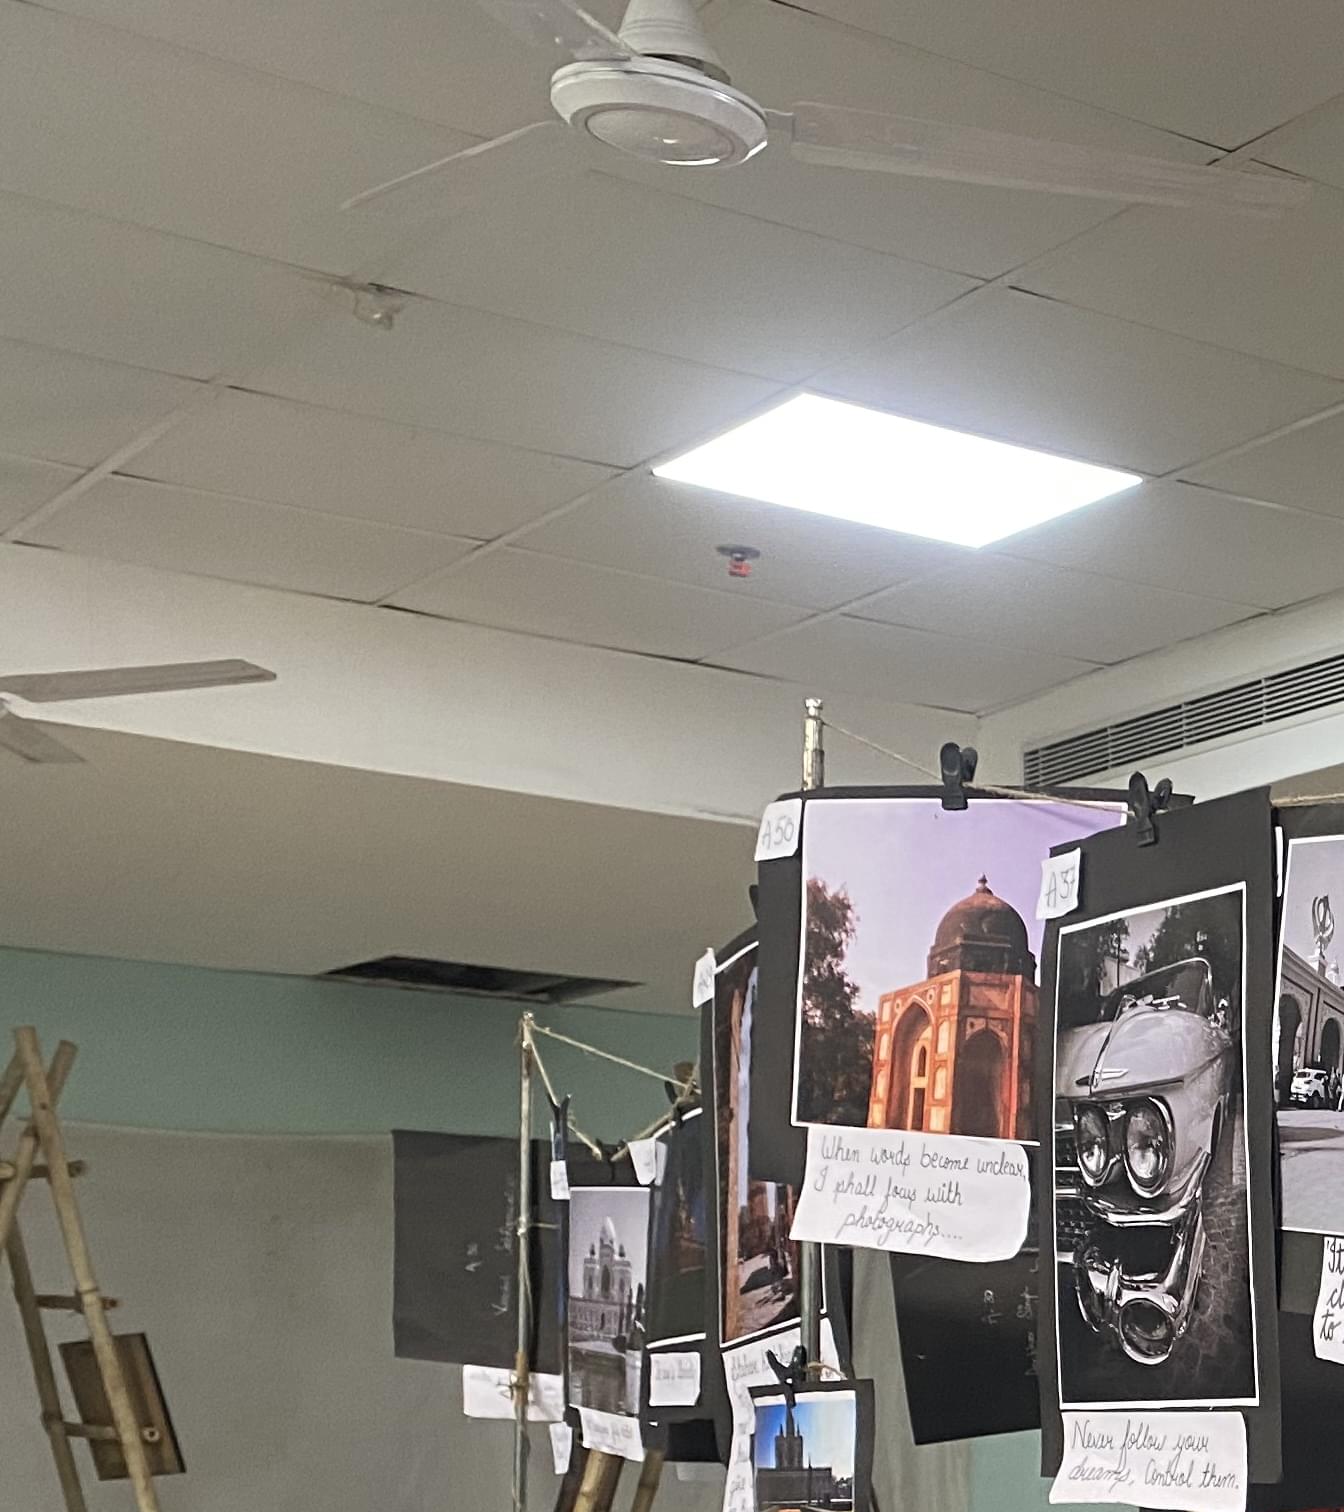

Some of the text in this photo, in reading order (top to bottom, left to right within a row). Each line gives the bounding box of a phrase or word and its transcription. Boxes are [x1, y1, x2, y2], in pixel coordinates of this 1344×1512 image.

[820, 1135, 861, 1162] When
[870, 1140, 911, 1177] words
[920, 1143, 970, 1171] become
[813, 1165, 964, 1212] I shall focus with
[1319, 1308, 1343, 1342] to
[1071, 1418, 1210, 1472] Never follow your
